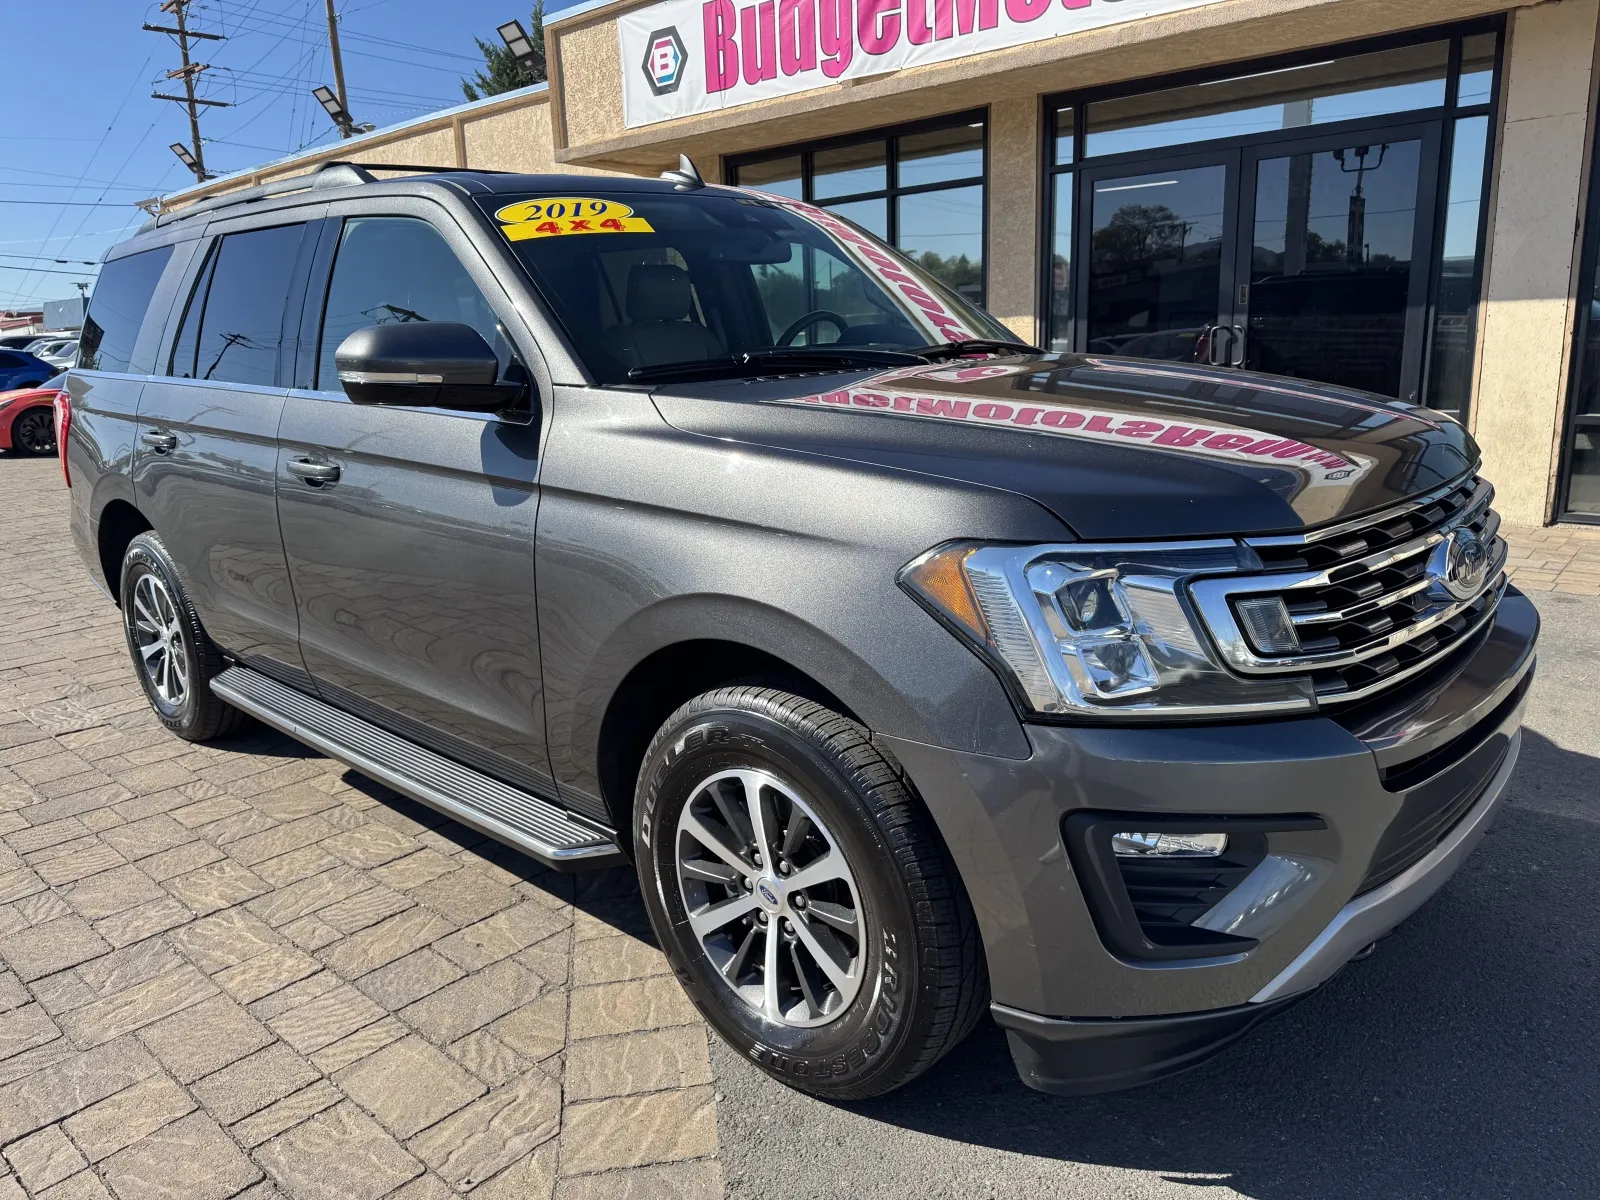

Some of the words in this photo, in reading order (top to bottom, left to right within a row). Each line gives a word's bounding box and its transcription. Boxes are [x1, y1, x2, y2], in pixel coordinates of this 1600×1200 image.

[653, 45, 676, 78] B
[702, 0, 1092, 94] Budge
[524, 202, 608, 221] 2019
[642, 726, 730, 849] DUELER
